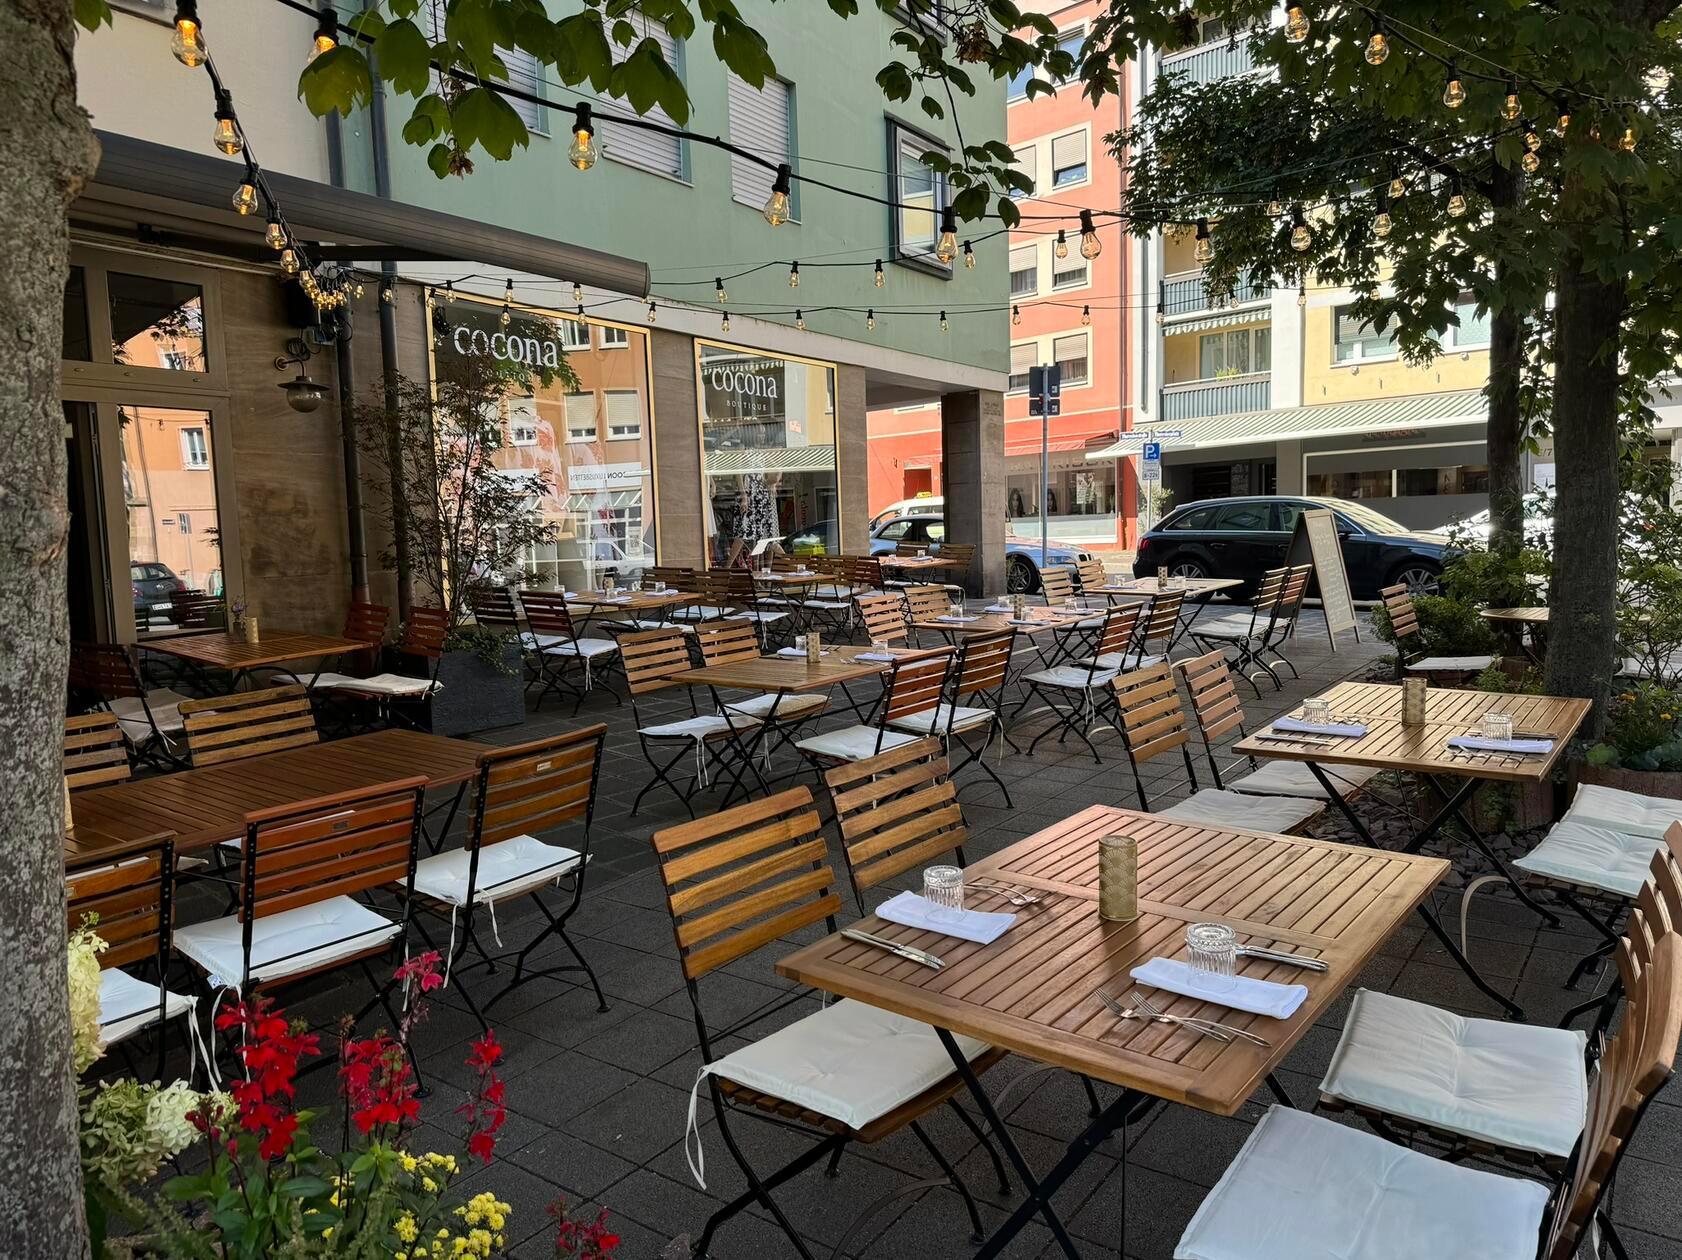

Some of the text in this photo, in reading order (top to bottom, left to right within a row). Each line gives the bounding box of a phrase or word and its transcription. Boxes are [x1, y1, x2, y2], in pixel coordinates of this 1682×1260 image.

[454, 326, 559, 368] cocona
[712, 368, 778, 399] cocona
[726, 400, 767, 411] BOUTIQUE
[1145, 445, 1155, 458] P
